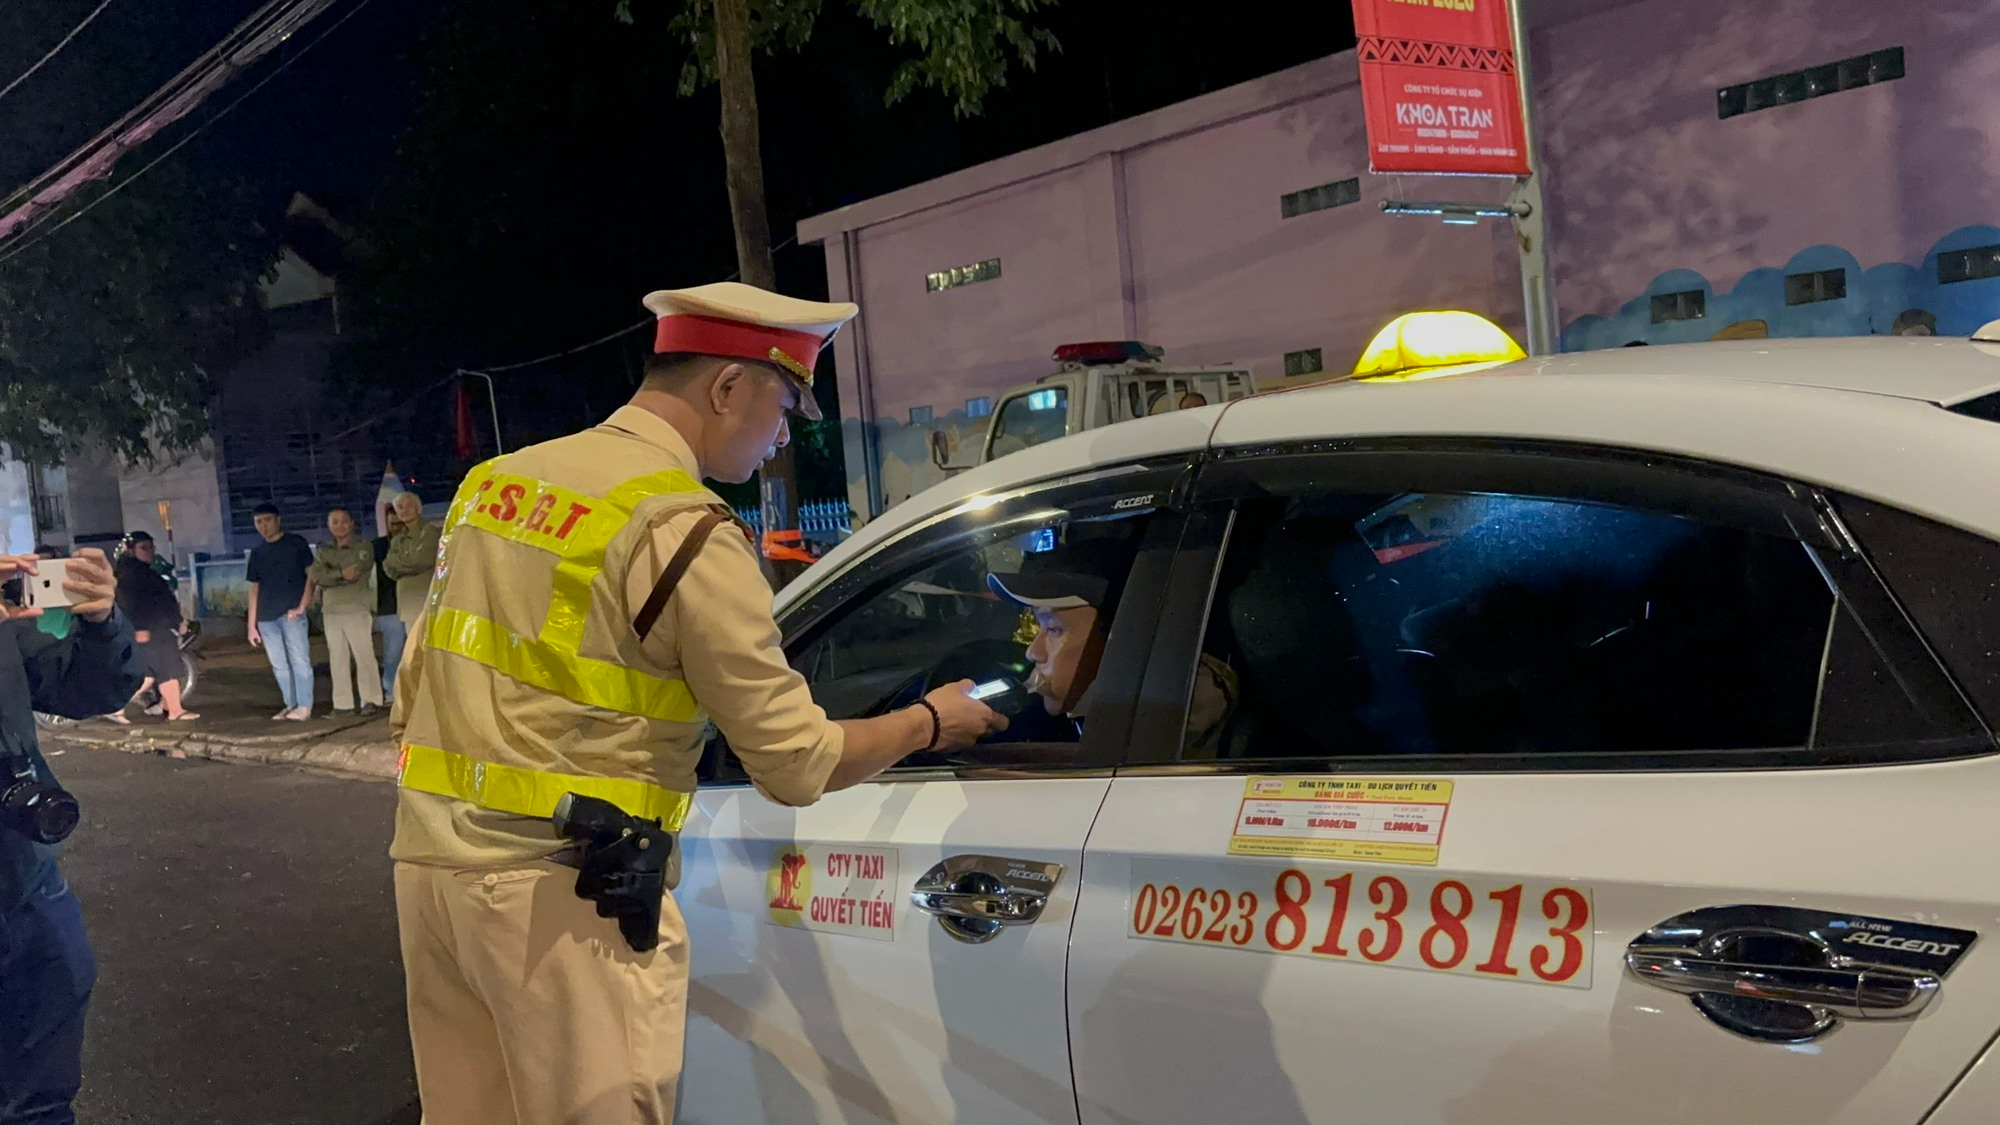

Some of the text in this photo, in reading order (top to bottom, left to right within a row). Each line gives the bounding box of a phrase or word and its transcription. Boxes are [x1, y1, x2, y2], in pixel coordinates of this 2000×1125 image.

[1396, 102, 1448, 126] KHOA
[1112, 494, 1155, 509] ACCENT
[1298, 780, 1316, 789] CÔNG
[1345, 782, 1362, 790] TAXI
[827, 852, 884, 880] CTY TAXI
[810, 887, 894, 929] QUYẾT TIẾN
[1843, 931, 1960, 956] ACCENT
